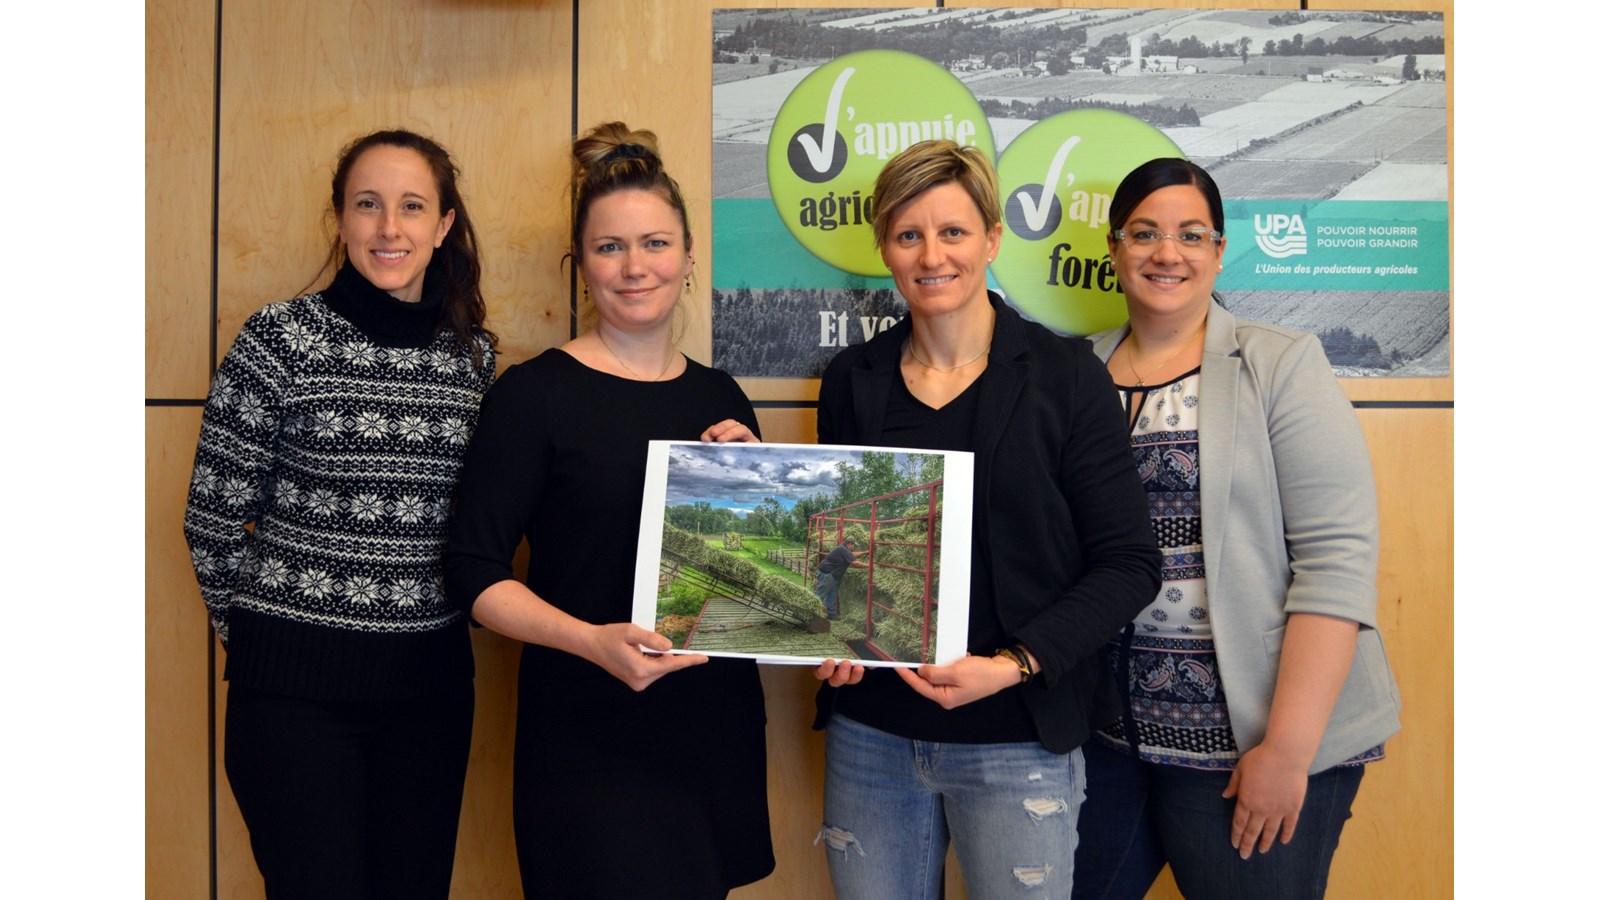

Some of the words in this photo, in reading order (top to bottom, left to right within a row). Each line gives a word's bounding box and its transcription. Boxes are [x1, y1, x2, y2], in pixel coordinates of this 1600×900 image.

[800, 190, 874, 231] agric
[1254, 214, 1306, 235] UPA
[1316, 226, 1366, 236] POUVOIR
[1368, 226, 1418, 236] NOURRIR
[1316, 238, 1366, 248] POUVOIR
[1368, 238, 1418, 248] GRANDIR
[1046, 243, 1125, 294] forê
[1255, 263, 1291, 274] L'Union
[1294, 264, 1311, 274] des
[1312, 264, 1372, 276] producteurs
[1374, 264, 1418, 277] agricoles
[819, 311, 849, 347] Et
